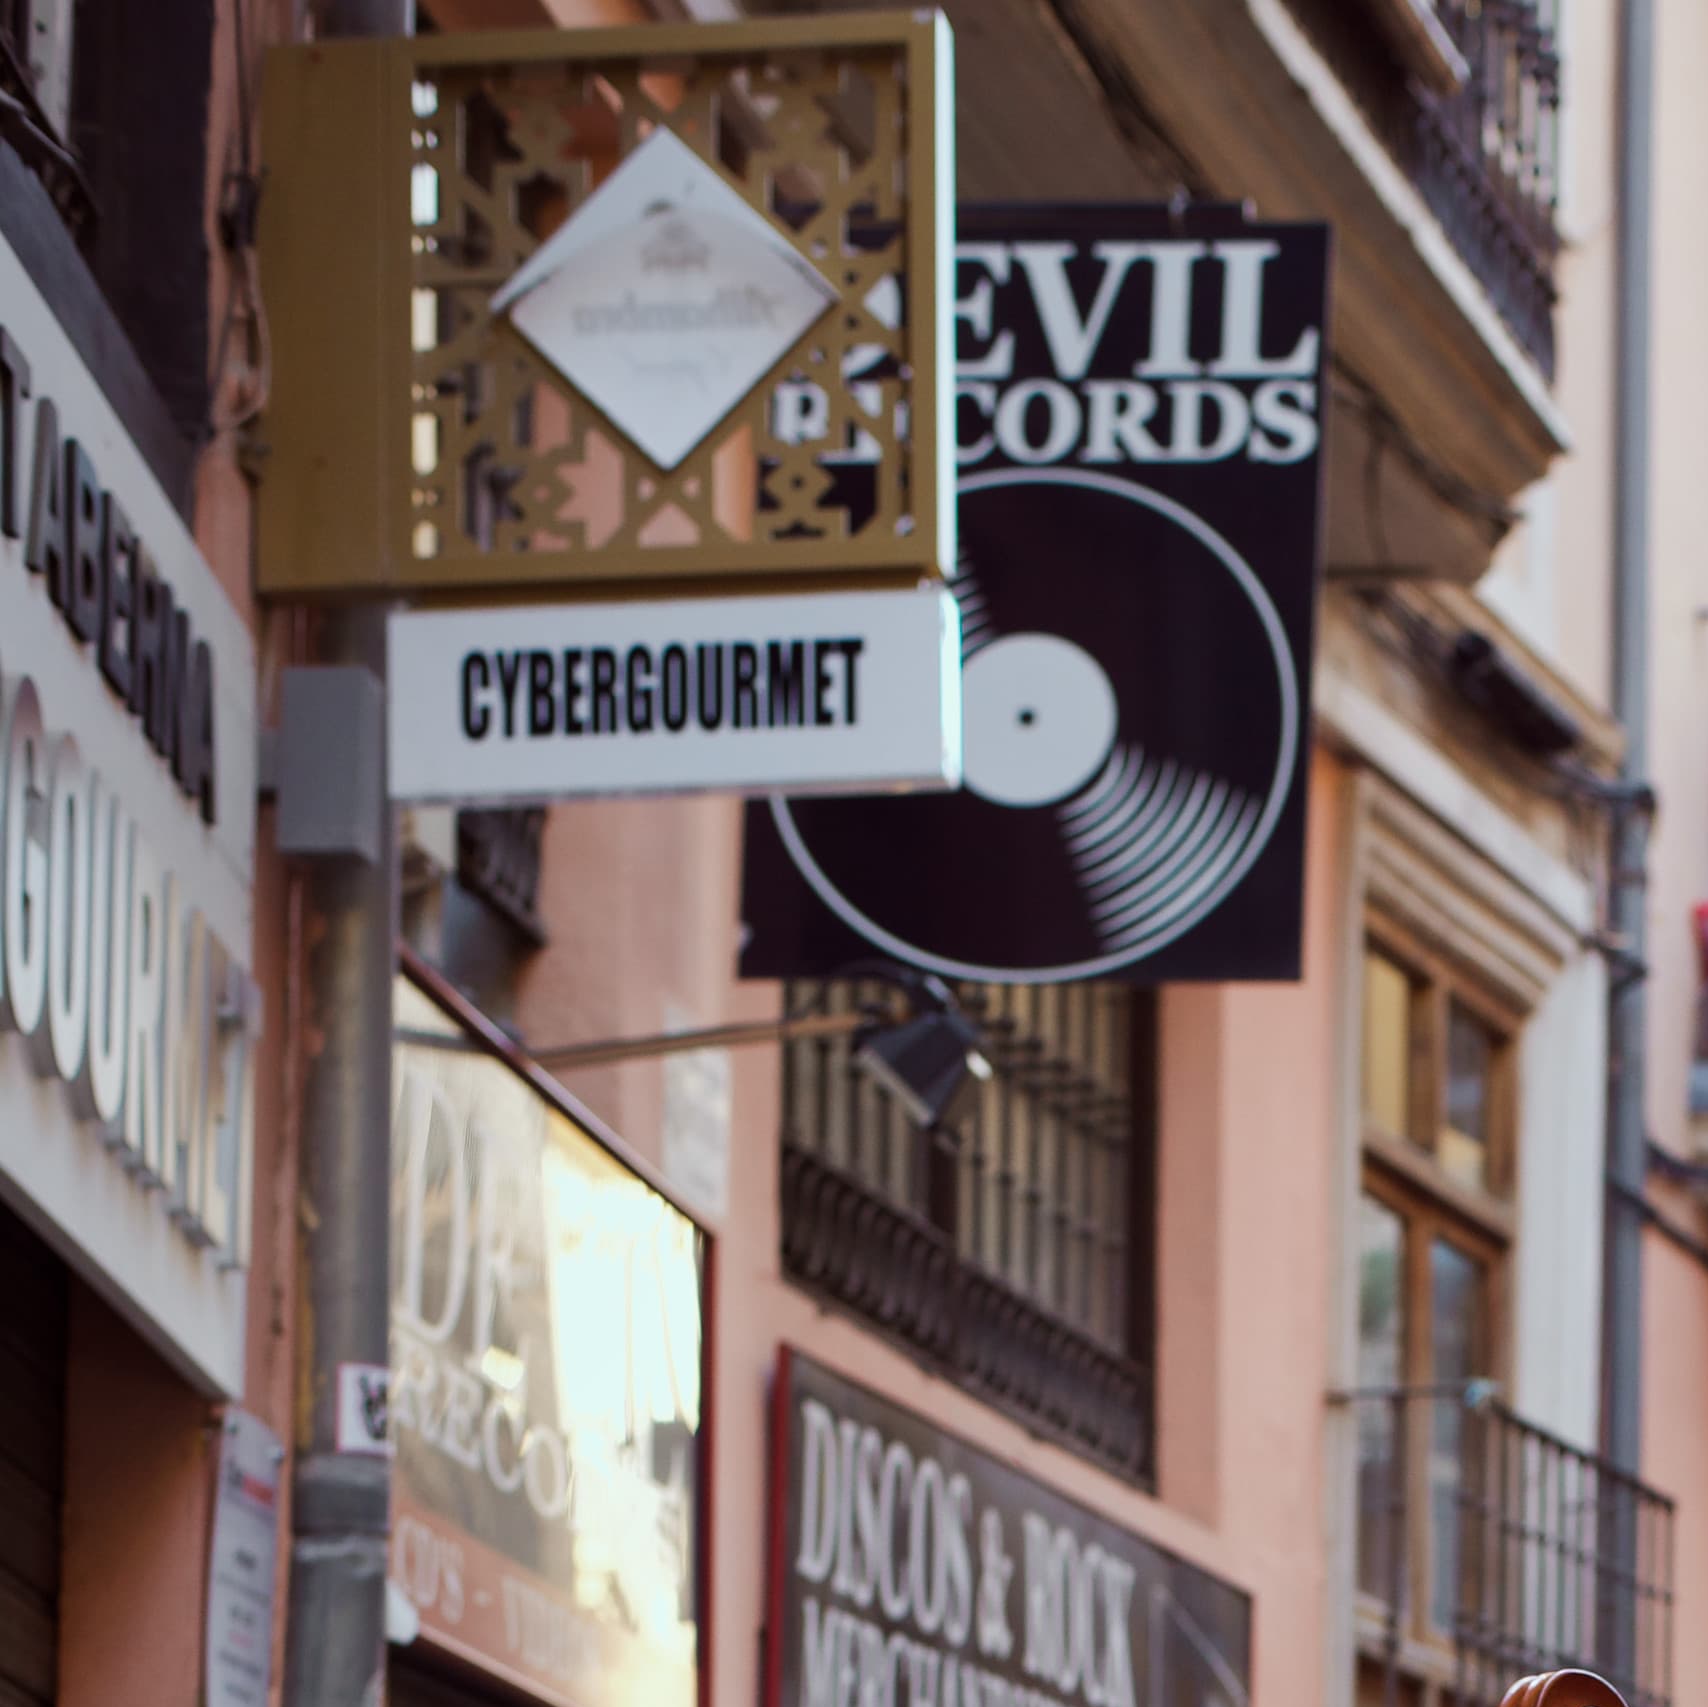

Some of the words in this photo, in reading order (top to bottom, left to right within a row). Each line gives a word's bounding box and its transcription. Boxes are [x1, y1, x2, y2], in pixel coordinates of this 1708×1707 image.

[842, 240, 1320, 380] EVIL
[461, 637, 864, 741] CYBERGOURMET
[0, 655, 260, 1270] GOURMET
[797, 1397, 974, 1650] DISCOS
[976, 1508, 1015, 1662] &
